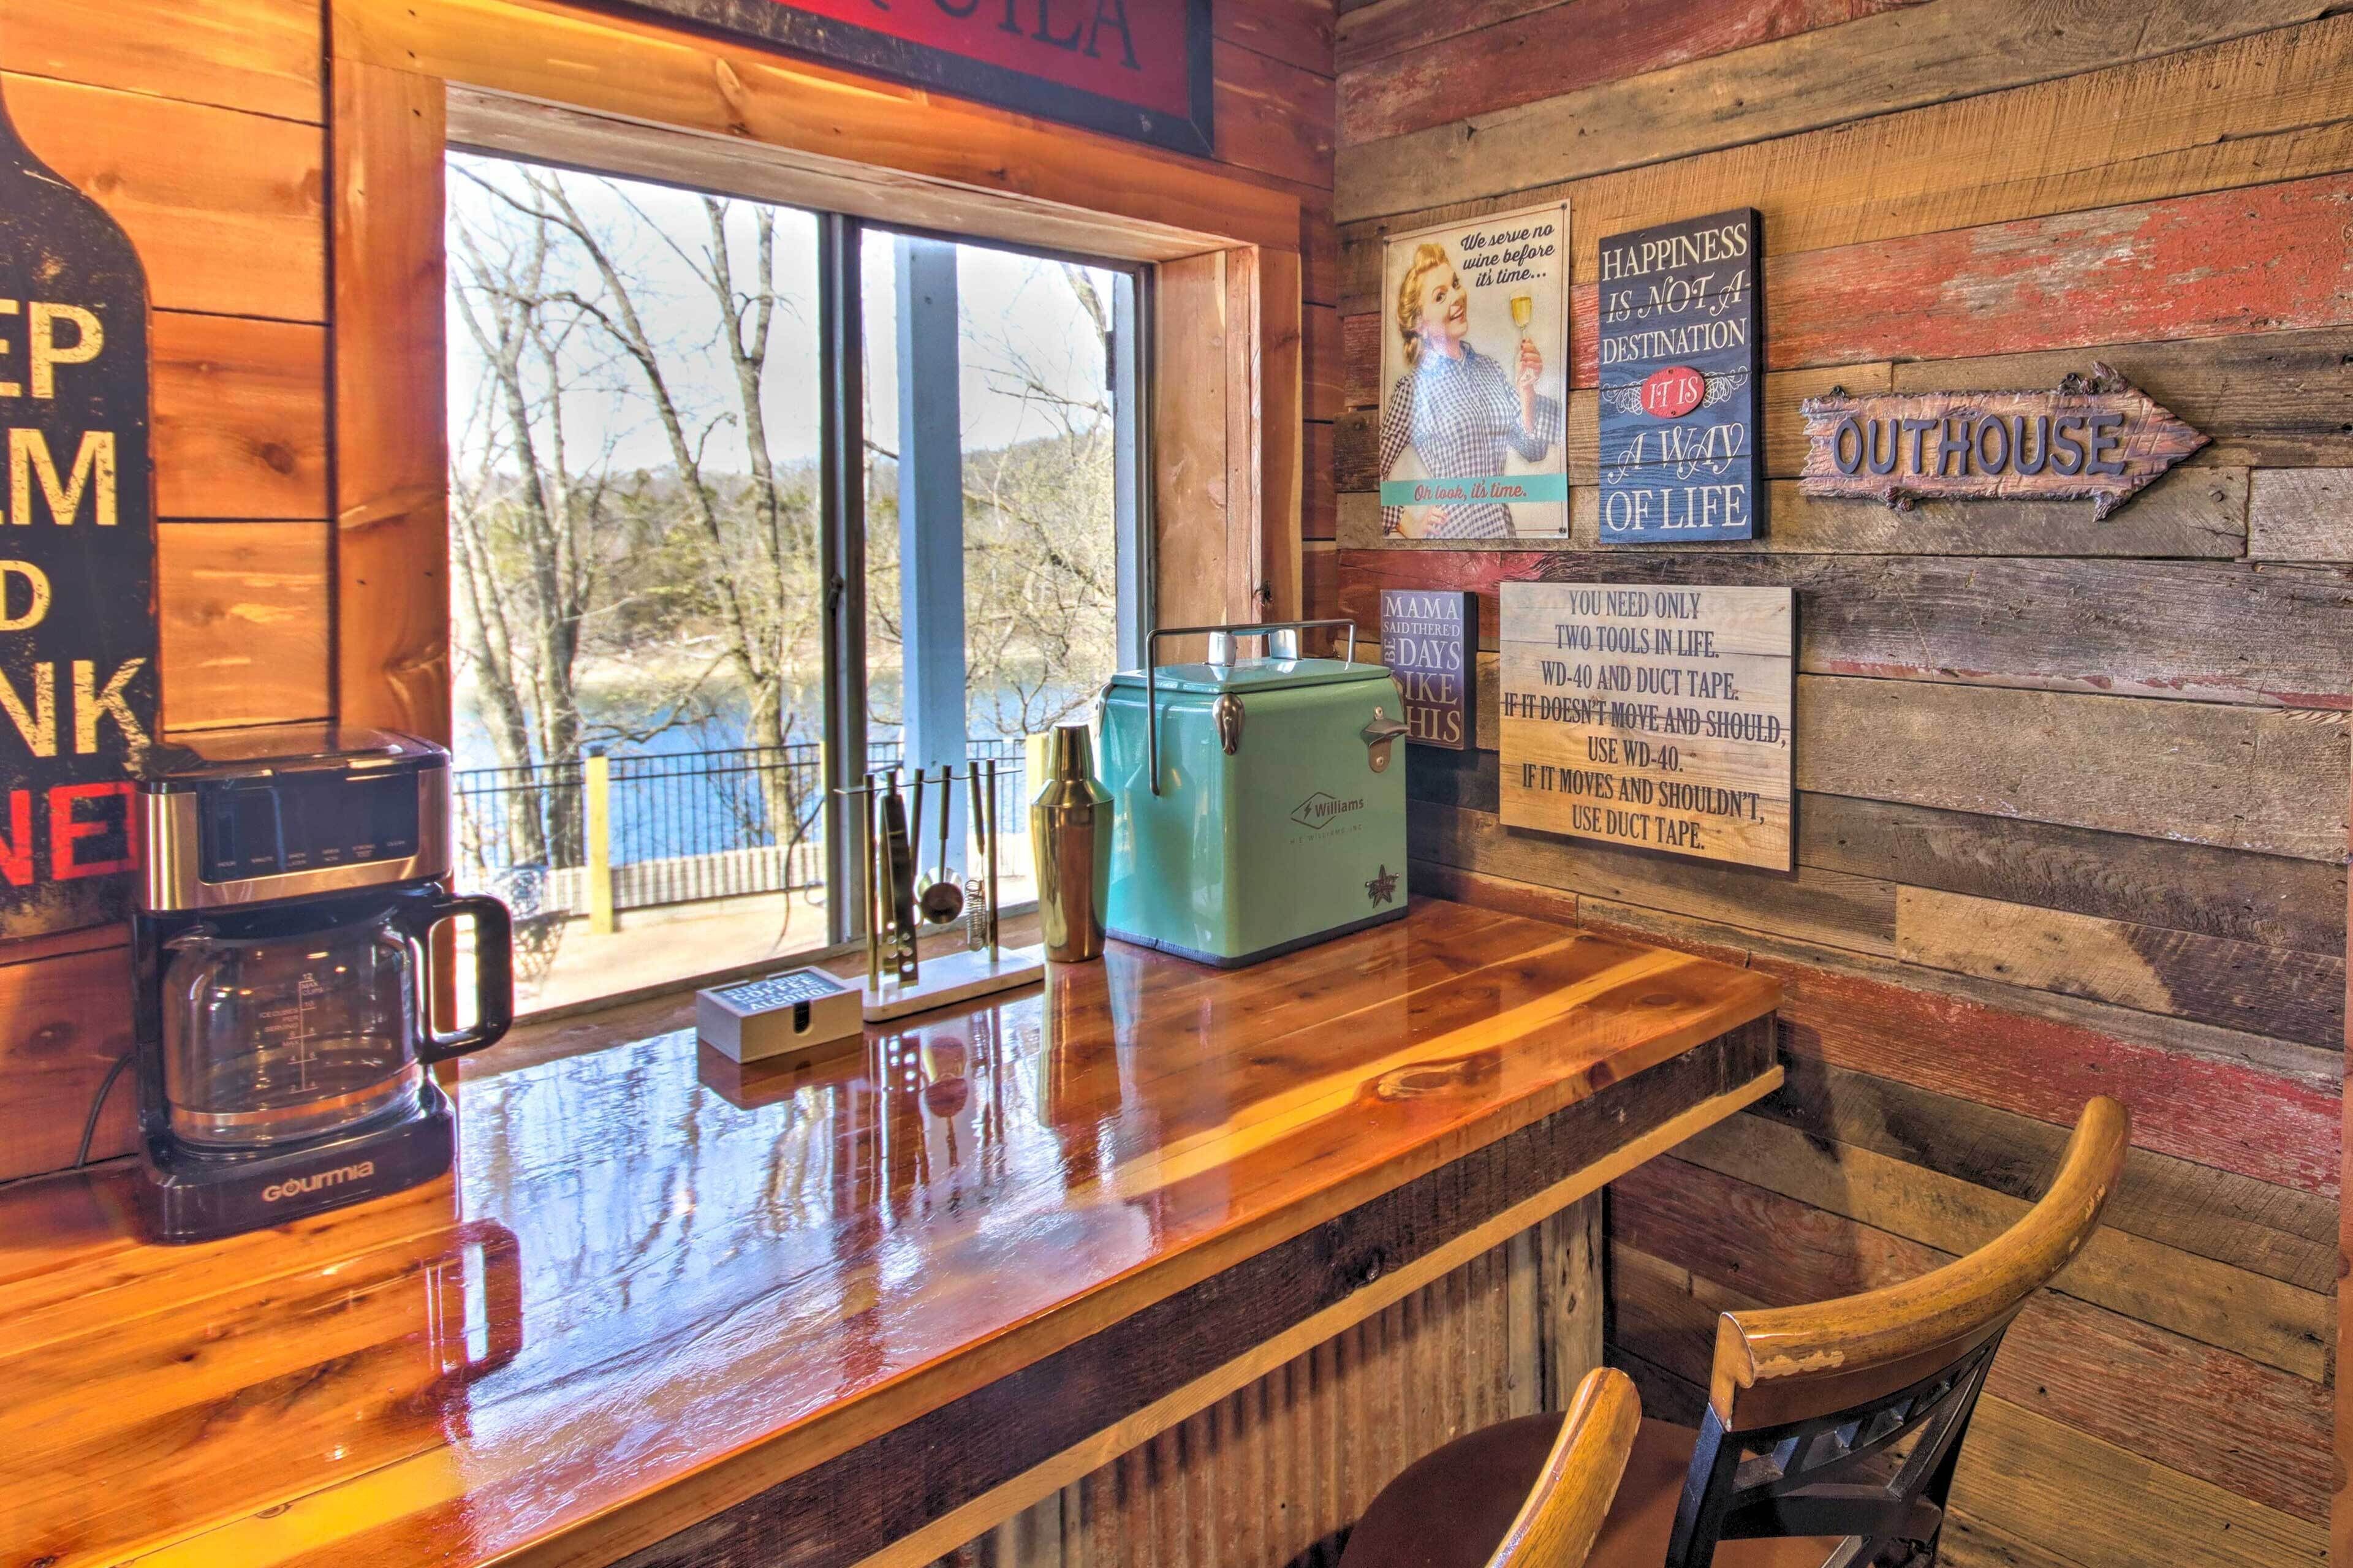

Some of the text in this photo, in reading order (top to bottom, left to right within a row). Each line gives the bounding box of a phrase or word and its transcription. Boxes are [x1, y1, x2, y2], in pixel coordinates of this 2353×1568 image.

[1460, 224, 1555, 251] We serve no
[1602, 223, 1747, 282] HAPPINESS
[1463, 244, 1555, 270] wine before
[1476, 268, 1547, 287] it's time...
[1606, 270, 1751, 323] IS NOT A
[1603, 317, 1747, 365] DESTINATION
[1648, 376, 1699, 409] IT IS
[1607, 423, 1745, 485] A WAY
[1833, 412, 2128, 476] OUTHOUSE
[1414, 479, 1527, 501] Oh look, it's time.
[1606, 484, 1747, 532] OF LIFE
[1383, 596, 1460, 621] MAMA
[1569, 590, 1701, 619] YOU NEED ONLY
[1382, 621, 1410, 634] SAID
[1555, 624, 1719, 659] TWO TOOLS IN LIFE.
[1384, 637, 1396, 664] BE
[1398, 638, 1461, 670] DAYS
[1392, 670, 1458, 705] IKE
[1541, 661, 1739, 701] WD-40 AND DUCT TAPE.
[1406, 705, 1461, 743] HIS
[1504, 692, 1786, 748] IF IT DOESN'T MOVE AND SHOULD,
[1588, 736, 1683, 772] USE WD-40.
[1315, 798, 1364, 817] Williams
[1522, 763, 1764, 825] IF IT MOVES AND SHOULDN'T,
[1572, 804, 1705, 850] USE DUCT TAPE.
[723, 984, 759, 997] STEP
[732, 979, 819, 1001] COFFEE
[749, 987, 835, 1010] ALCOHOL
